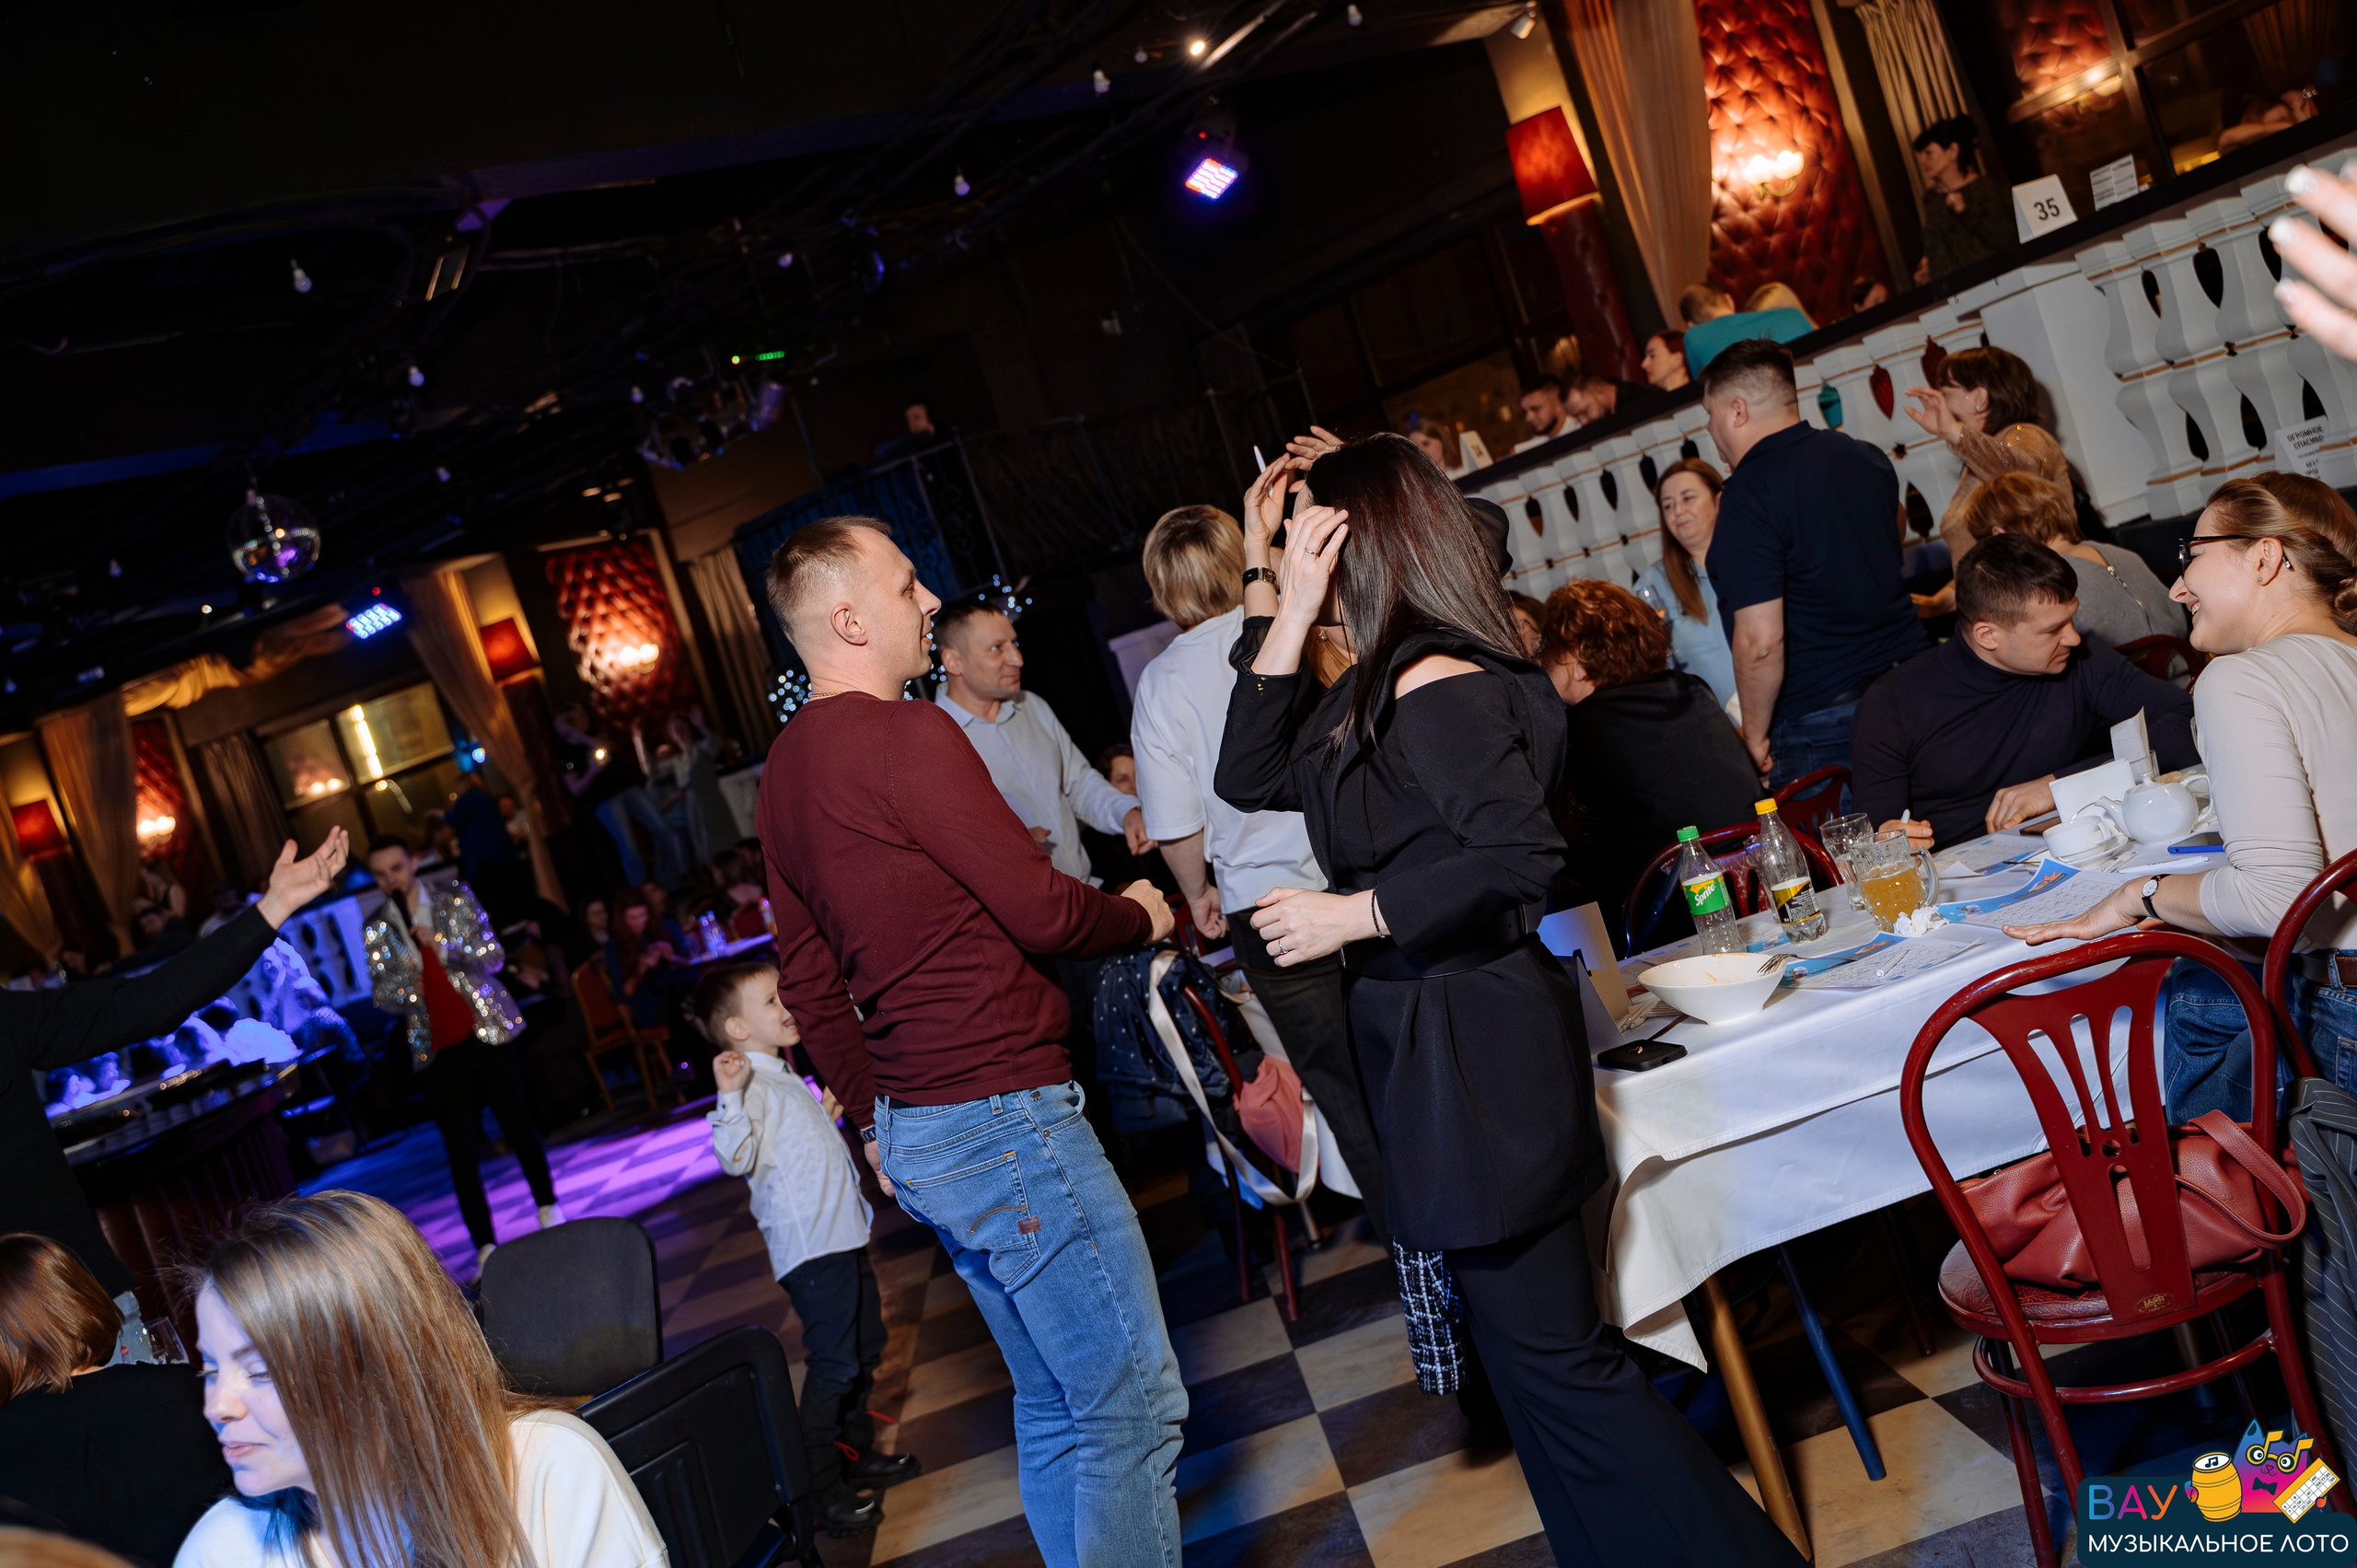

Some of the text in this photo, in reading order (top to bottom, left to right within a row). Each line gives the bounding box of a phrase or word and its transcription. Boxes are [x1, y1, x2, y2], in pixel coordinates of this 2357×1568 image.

[2033, 197, 2060, 221] 35
[2286, 424, 2324, 442] ОГРОМНОЕ
[1694, 883, 1716, 907] Sprite
